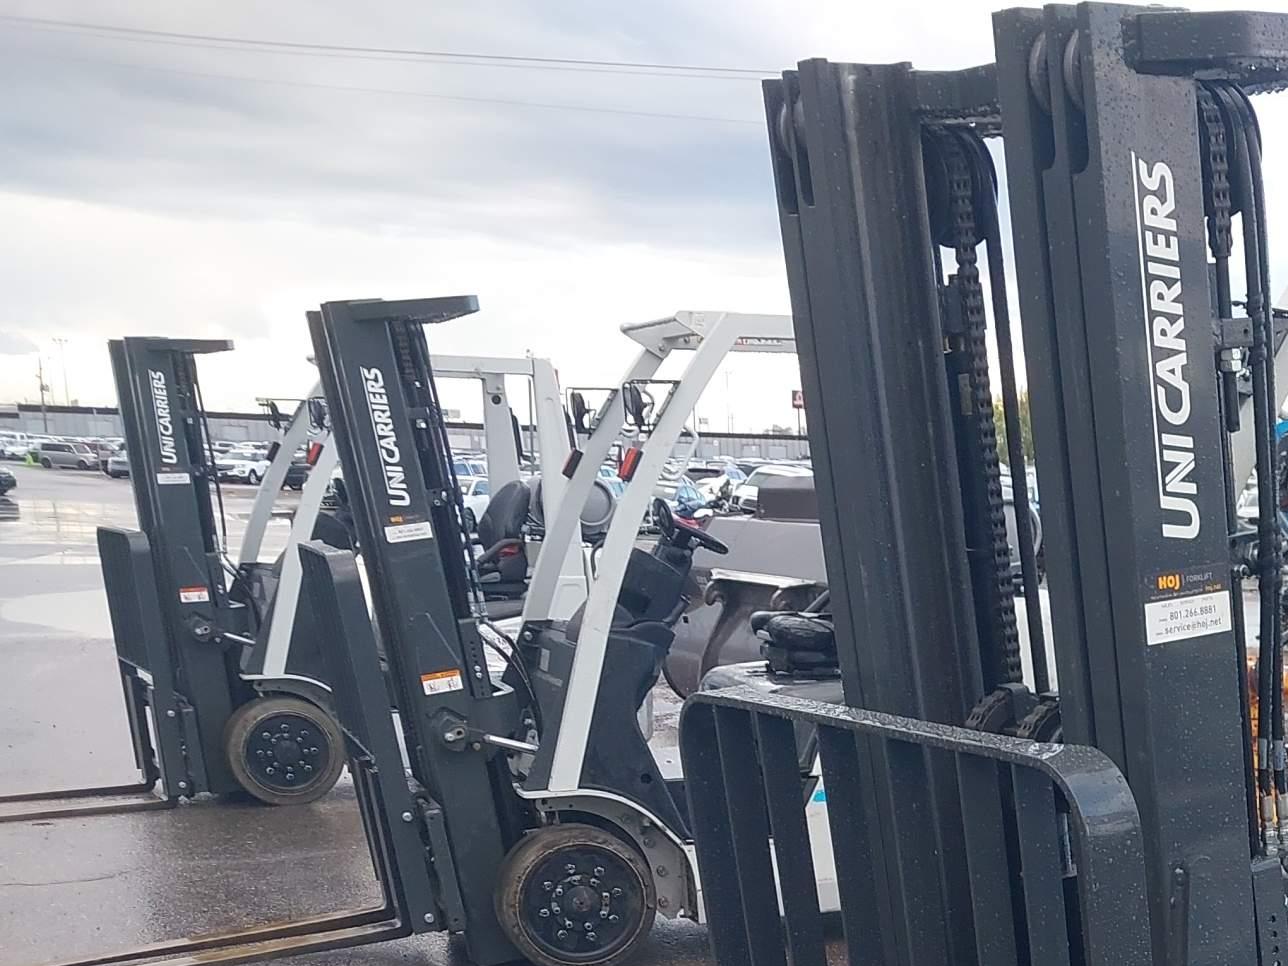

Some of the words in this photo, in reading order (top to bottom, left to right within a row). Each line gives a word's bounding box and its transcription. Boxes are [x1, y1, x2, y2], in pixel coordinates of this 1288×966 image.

[1131, 151, 1200, 540] UNICARRIERS
[148, 369, 178, 465] UNICARRIERS
[360, 366, 411, 507] UNICARRIERS
[1158, 574, 1180, 590] HOJ
[1186, 572, 1212, 582] FORKLIFT
